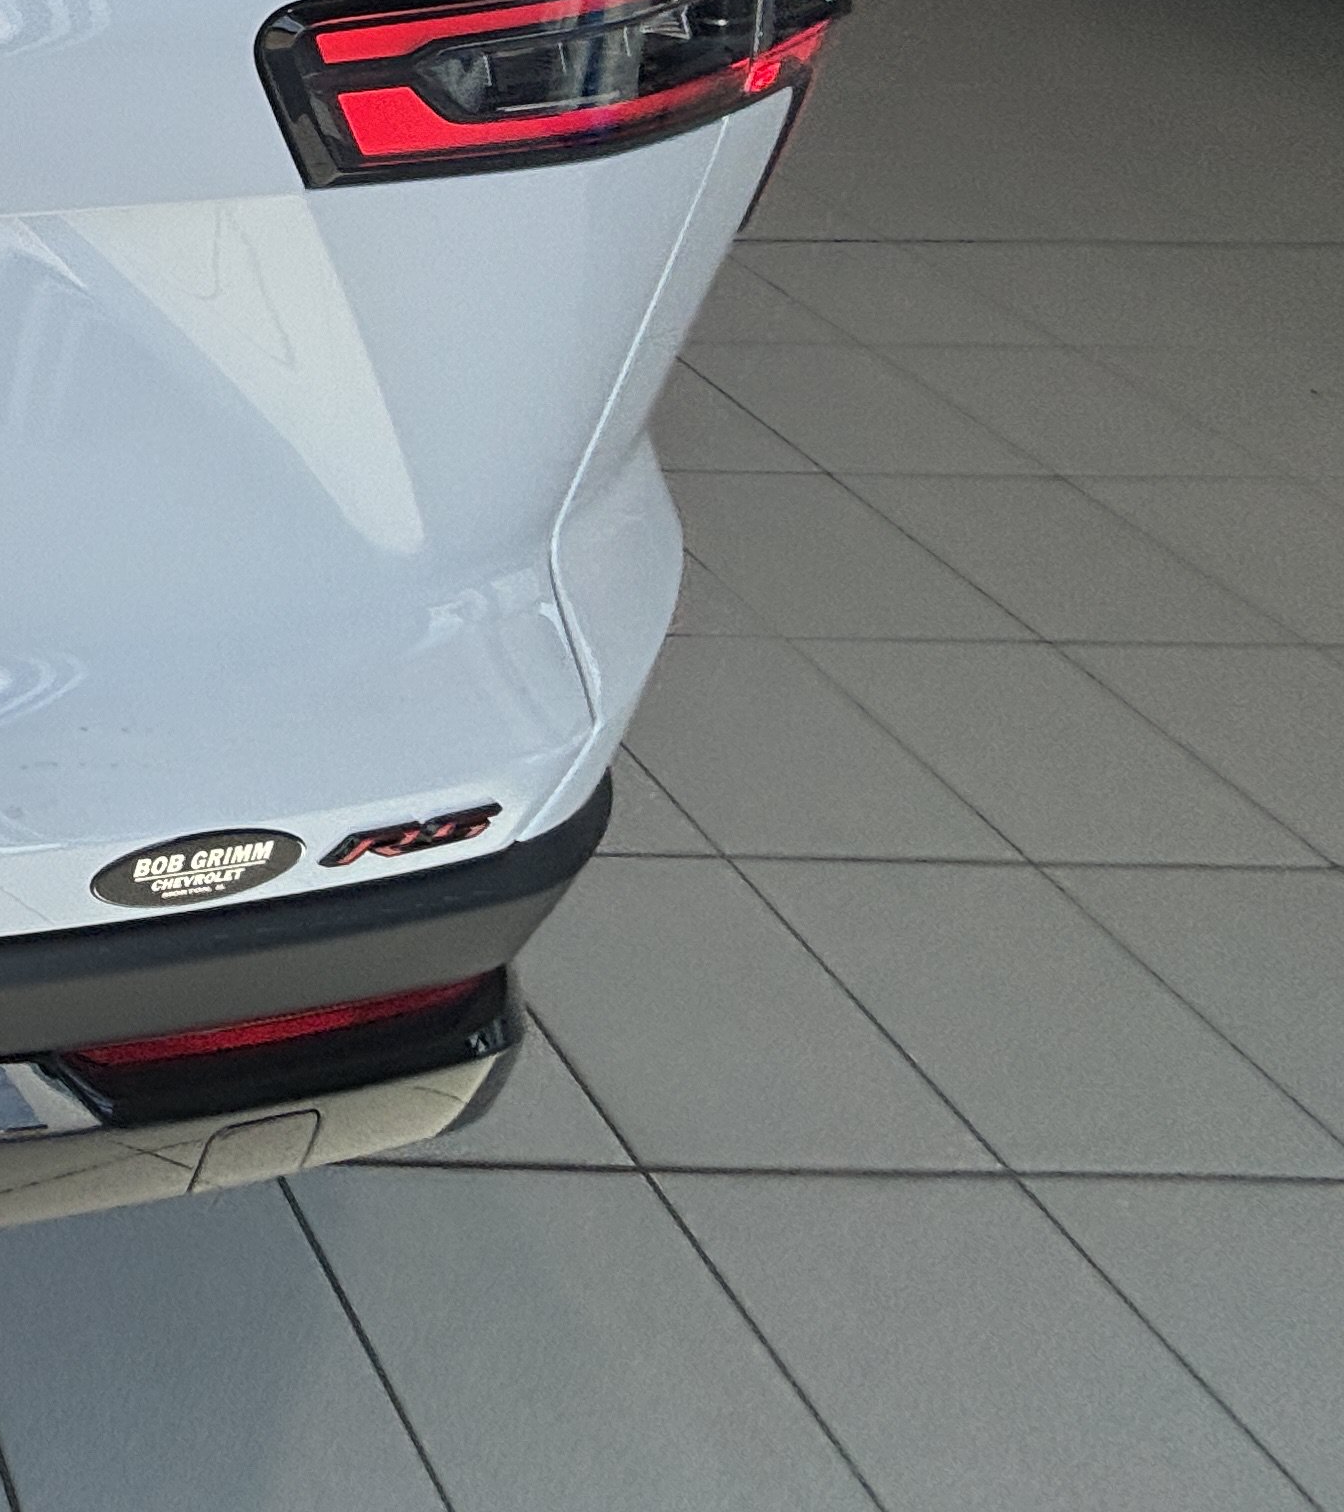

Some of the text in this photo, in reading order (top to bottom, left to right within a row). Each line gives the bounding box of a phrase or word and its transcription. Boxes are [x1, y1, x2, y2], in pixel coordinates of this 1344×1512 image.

[133, 840, 275, 878] BOB GRIMM
[151, 868, 246, 892] CHEVROLET
